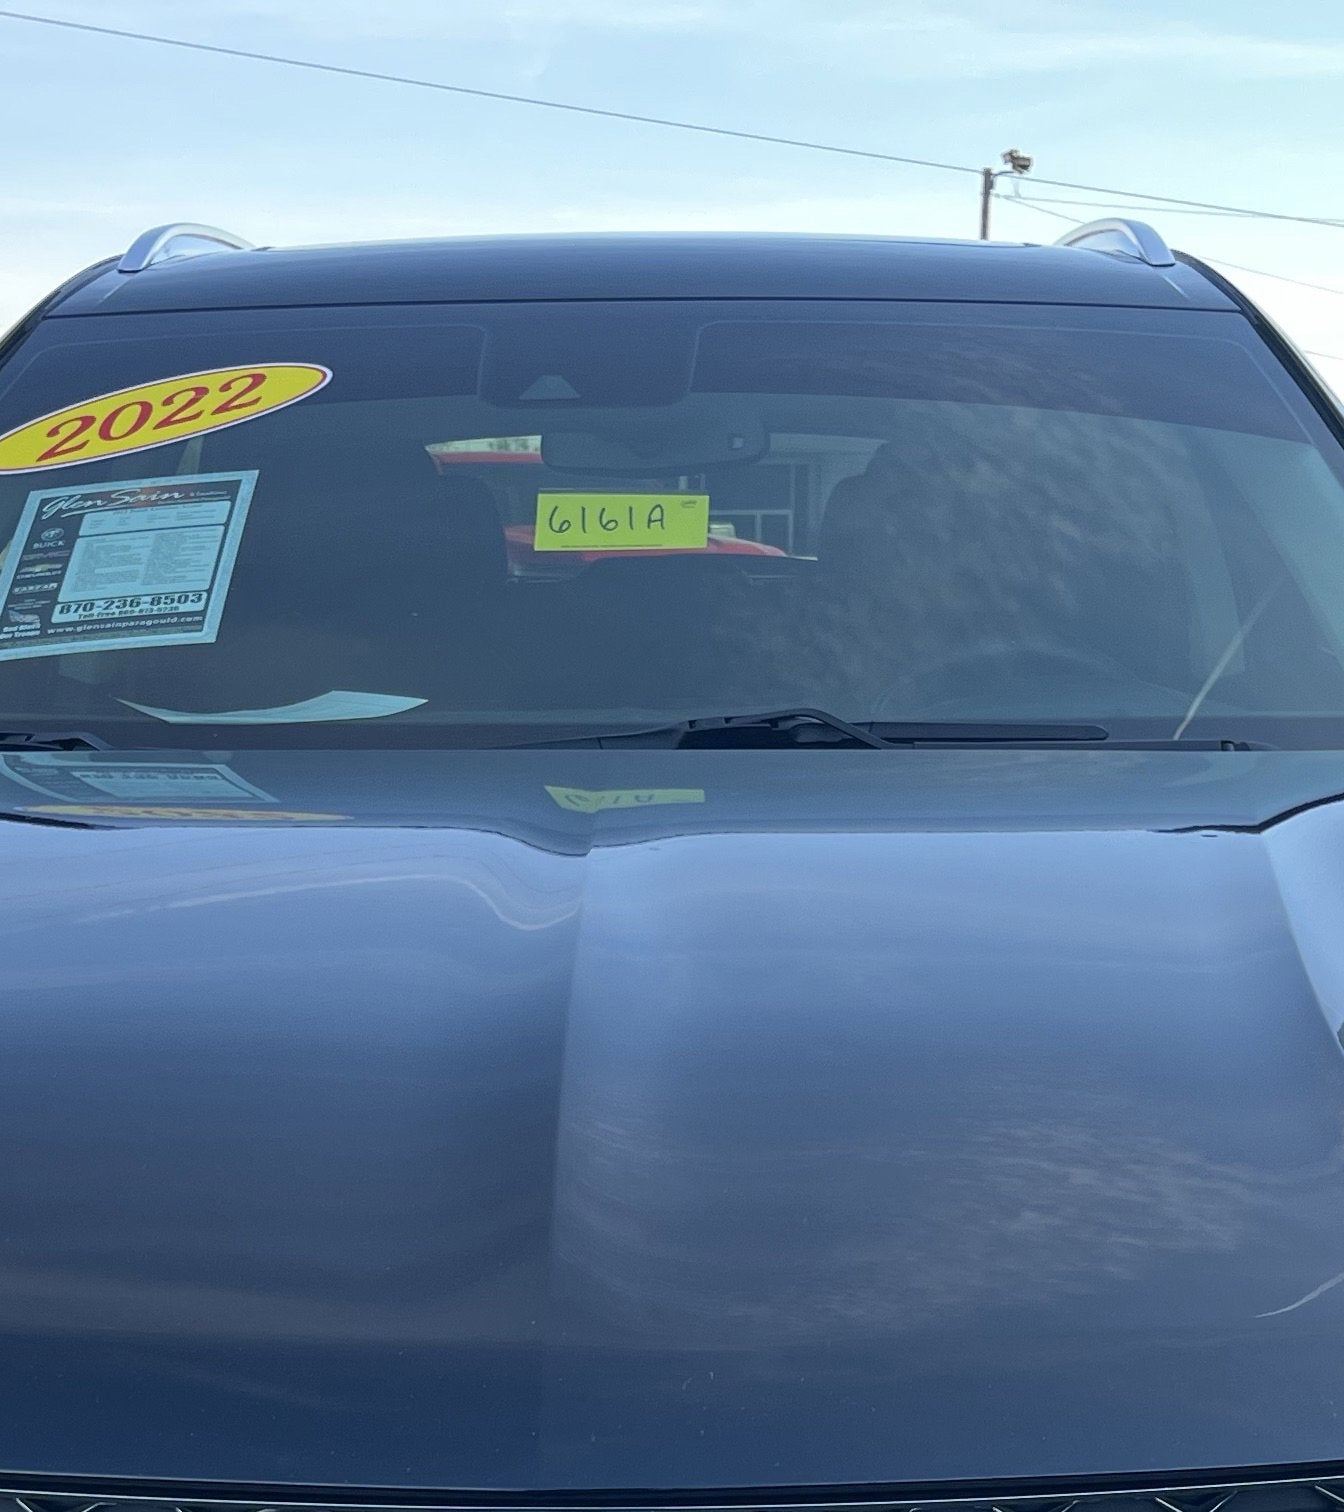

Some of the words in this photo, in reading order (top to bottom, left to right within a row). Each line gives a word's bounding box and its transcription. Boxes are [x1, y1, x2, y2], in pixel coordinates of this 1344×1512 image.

[36, 373, 267, 462] 2022
[42, 495, 108, 520] Glen
[106, 488, 185, 507] Sain
[549, 504, 665, 534] 6161A
[59, 593, 203, 614] 870-236-8503
